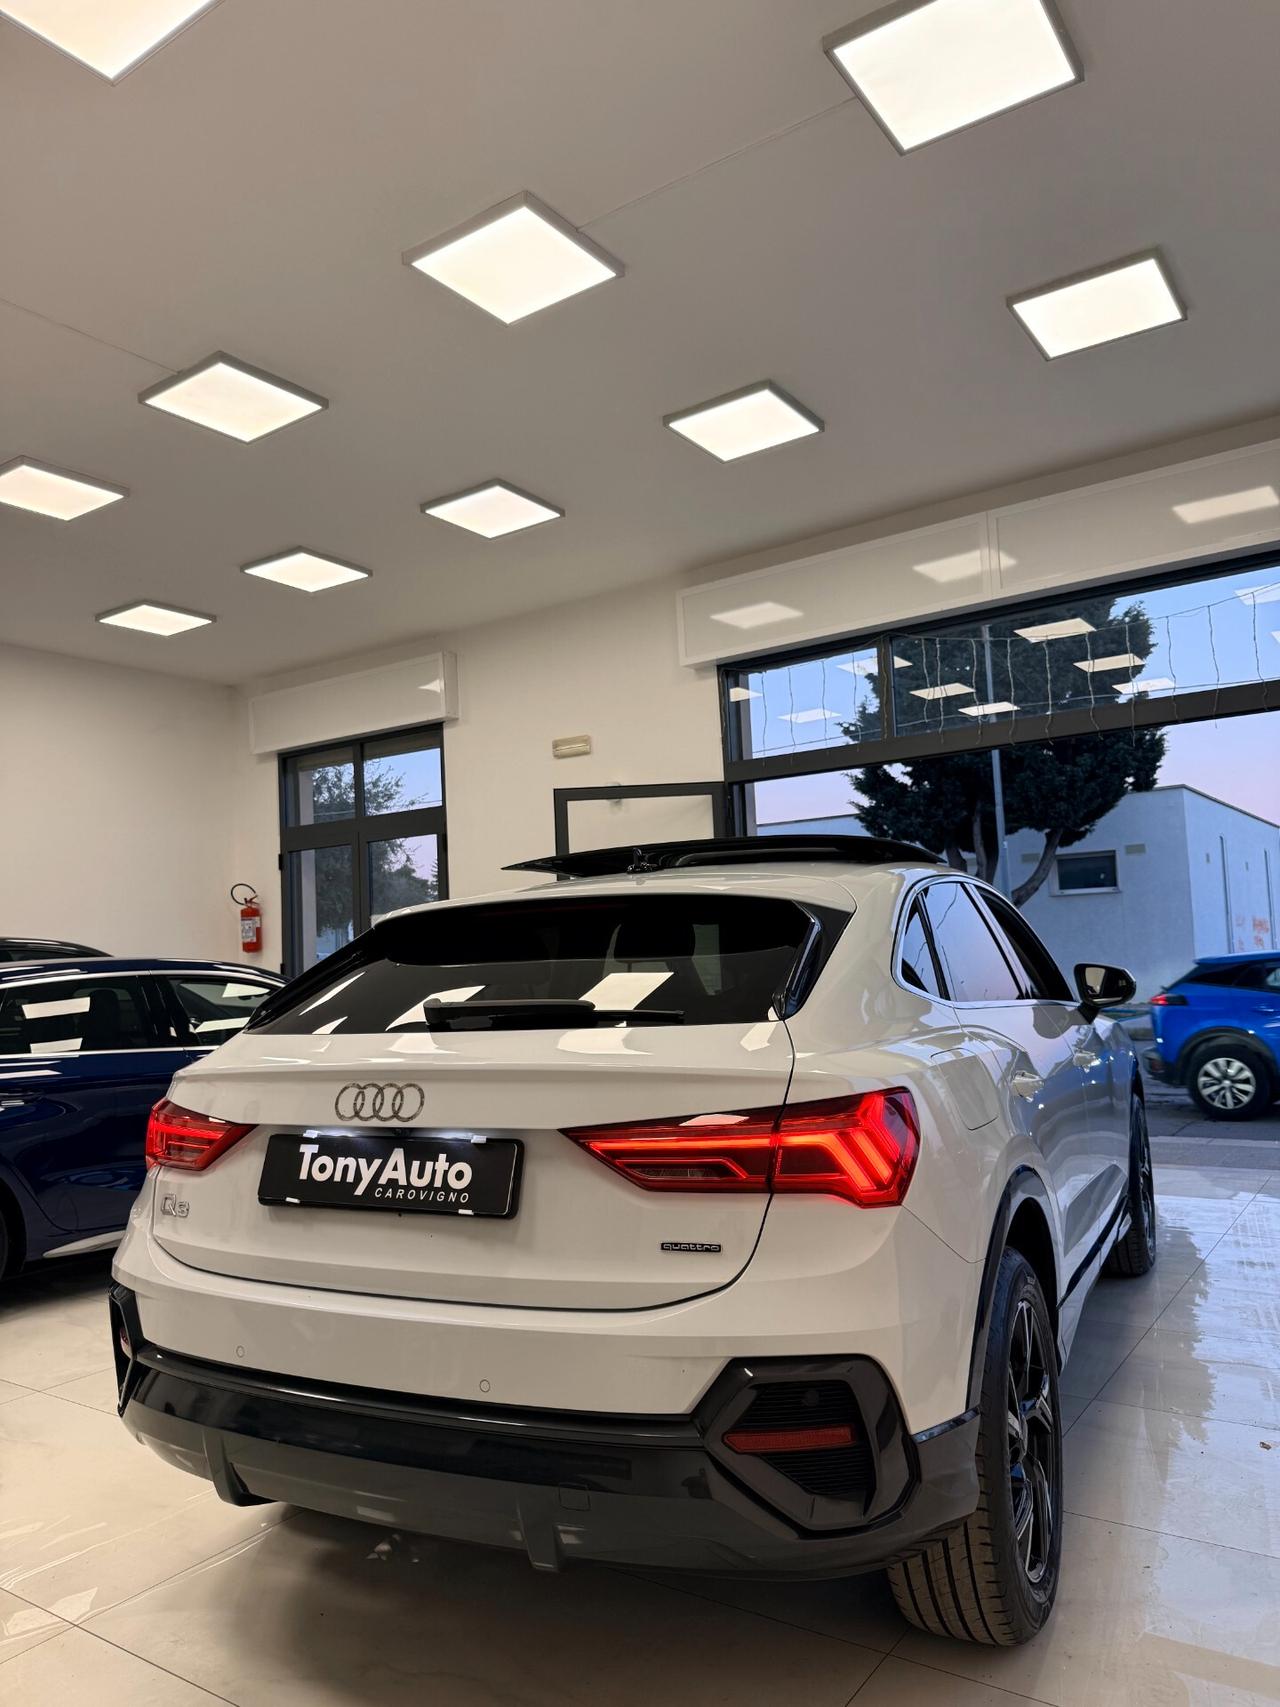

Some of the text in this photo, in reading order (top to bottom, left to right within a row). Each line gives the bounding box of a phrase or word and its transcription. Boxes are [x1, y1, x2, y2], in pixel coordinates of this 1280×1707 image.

[299, 1144, 473, 1196] TonyAuto
[374, 1187, 469, 1204] CAROVIGNO
[161, 1194, 190, 1218] Q3
[662, 1243, 720, 1251] quattro
